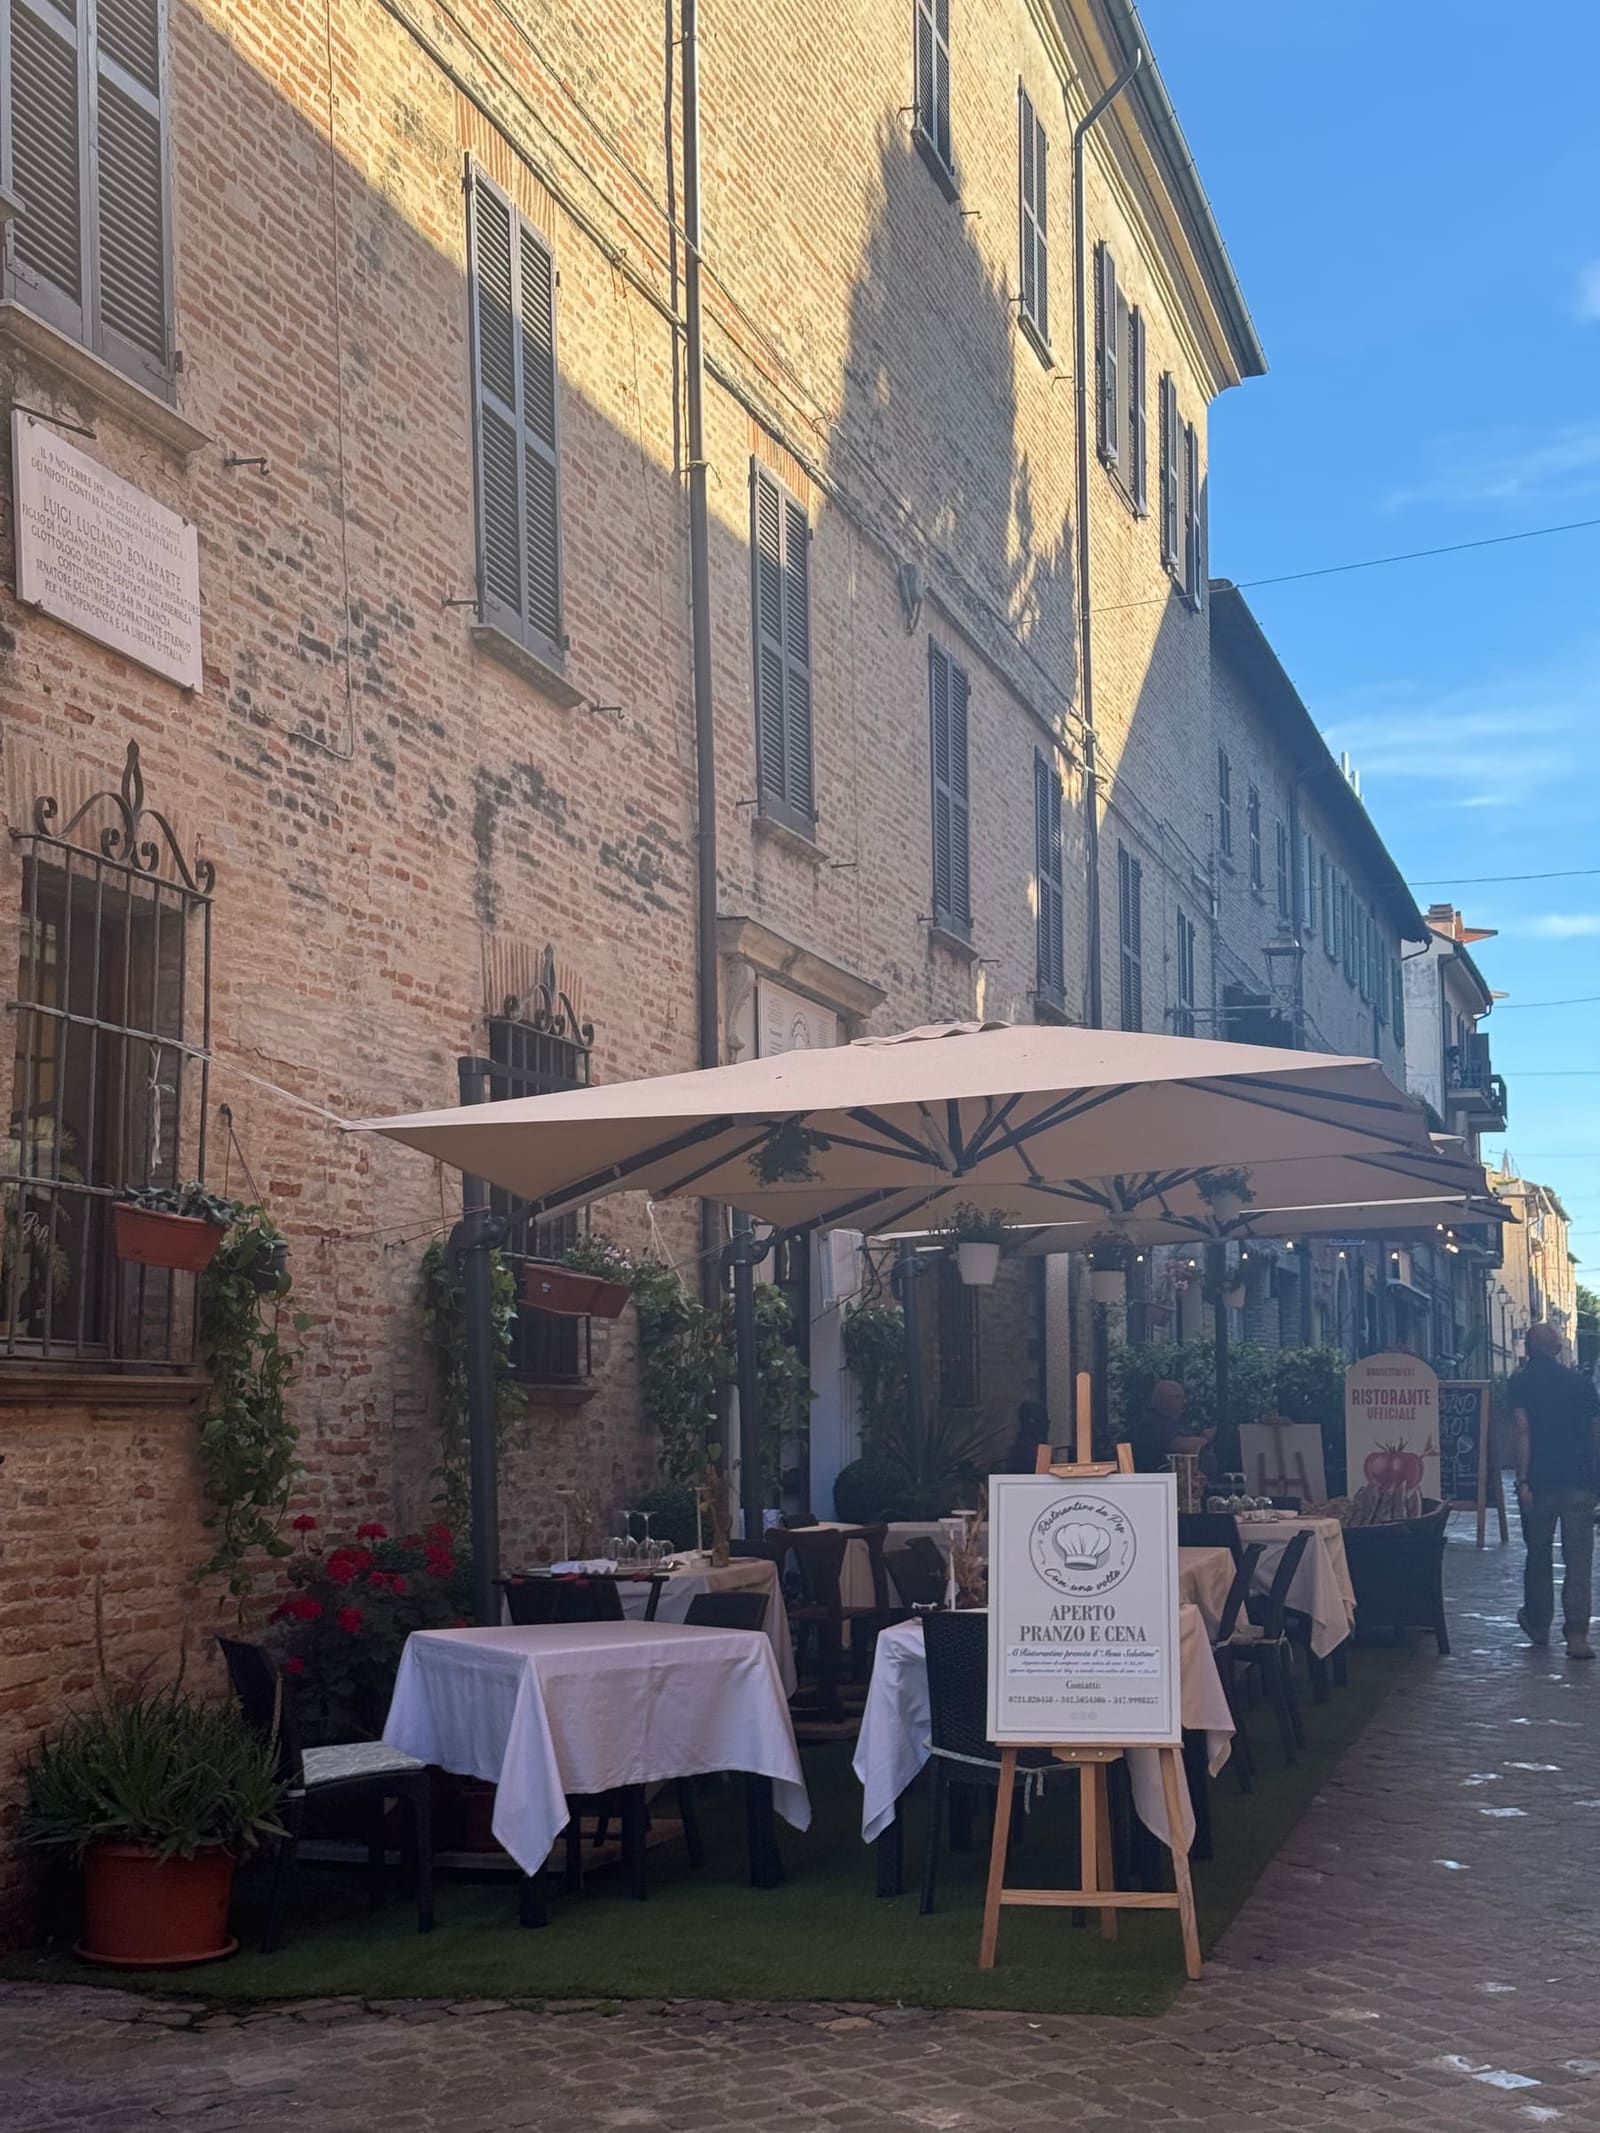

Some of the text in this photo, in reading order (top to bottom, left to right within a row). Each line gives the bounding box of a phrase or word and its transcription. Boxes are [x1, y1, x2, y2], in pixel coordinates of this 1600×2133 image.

[23, 503, 46, 526] FIGLIO
[58, 524, 89, 551] LUCIANO
[31, 524, 81, 561] GLOTTOLOGO
[44, 495, 181, 591] LUIGI LUCIANO BONAPARTE
[36, 559, 72, 586] SENATORE
[58, 556, 105, 589] COSTITUENTE
[1352, 1389, 1431, 1405] RISTORANTE
[1367, 1407, 1416, 1420] UFFICIALE
[1038, 1501, 1125, 1536] Ristorantino da Pep
[1096, 1570, 1121, 1590] volta
[1050, 1604, 1115, 1621] APERTO
[1020, 1625, 1146, 1642] PRANZO E CENA
[1065, 1680, 1102, 1689] Contatti:
